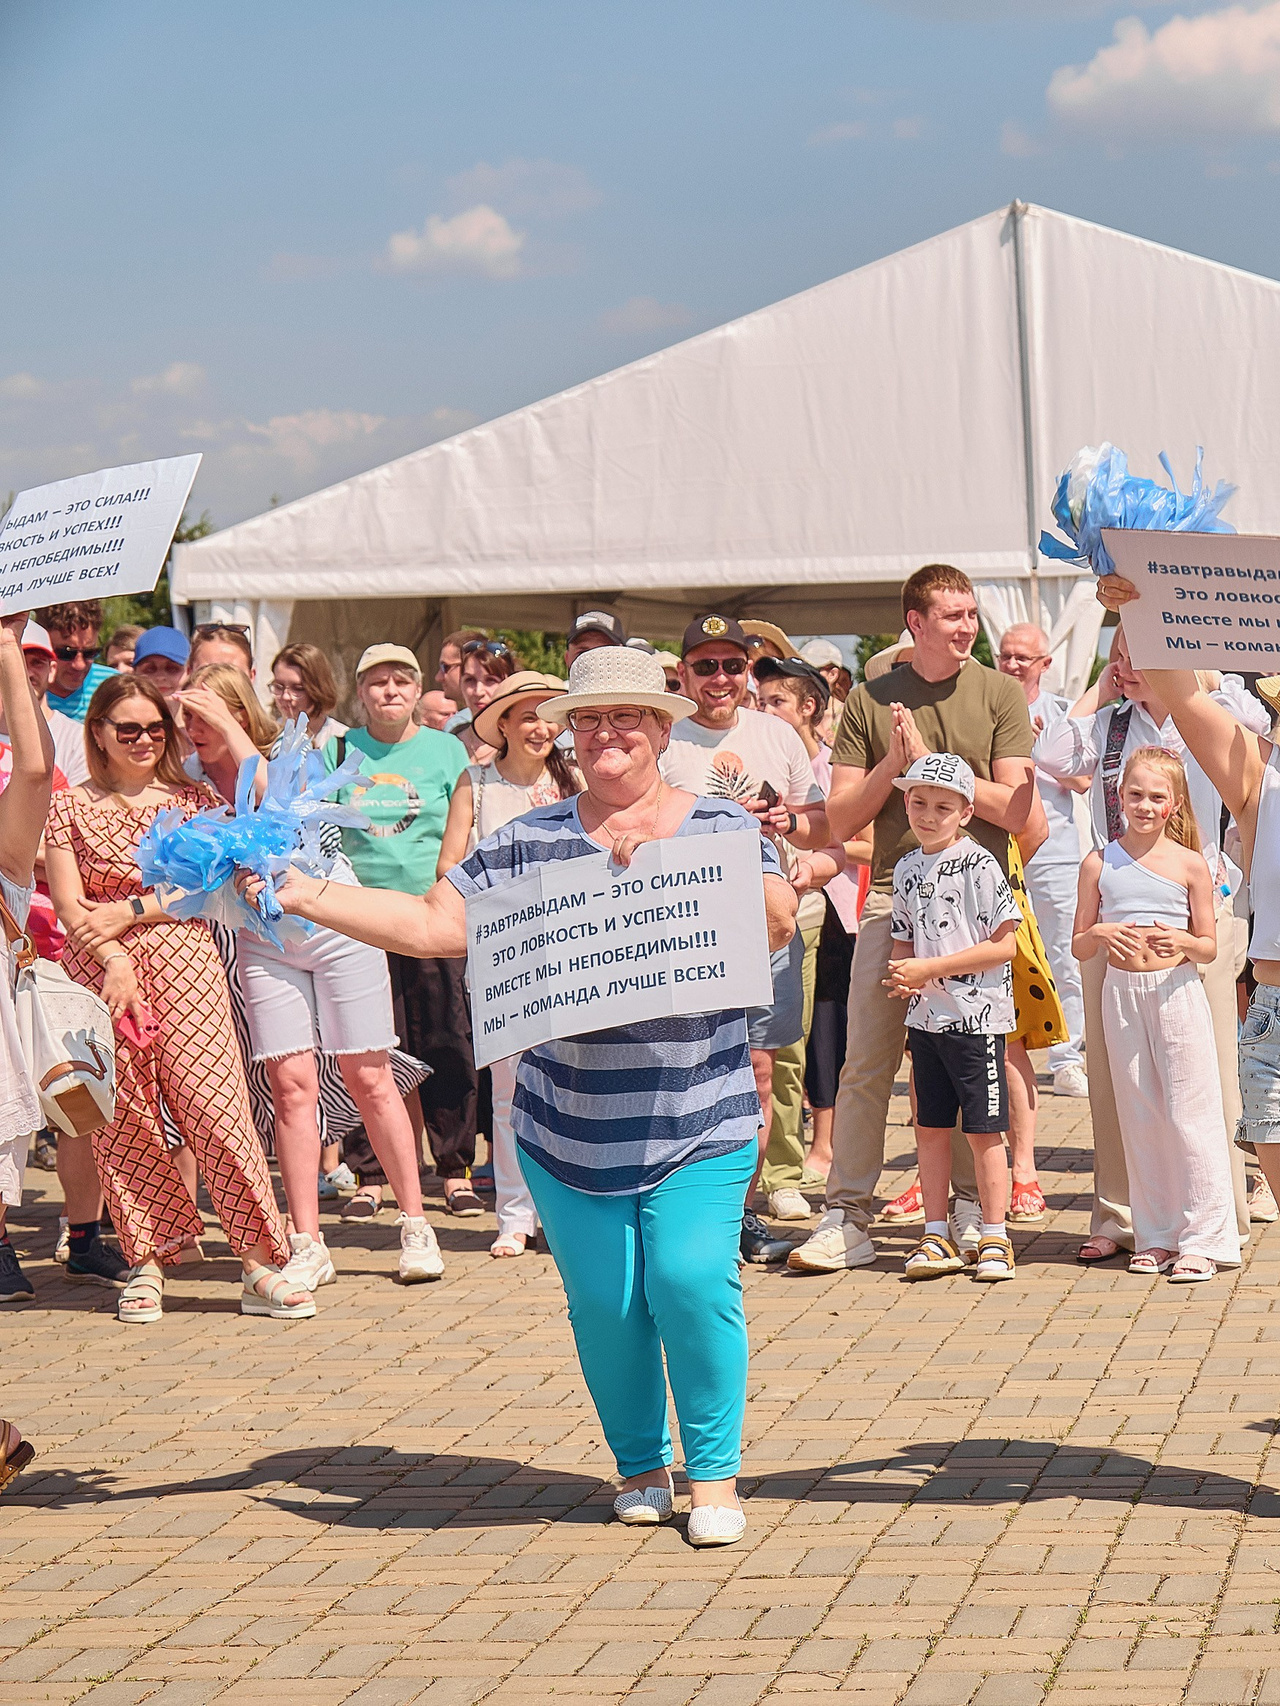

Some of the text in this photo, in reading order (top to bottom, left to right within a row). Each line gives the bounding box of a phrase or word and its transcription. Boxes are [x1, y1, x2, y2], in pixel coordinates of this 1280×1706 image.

[65, 500, 91, 515] ЭТО
[95, 487, 151, 508] СИЛА!!!
[49, 529, 60, 541] И
[63, 515, 123, 538] УСПЕХ!!!
[10, 538, 125, 572] НЕПОБЕДИМЫ!!!
[27, 570, 75, 591] ЛУЧШЕ
[79, 562, 120, 580] ВСЕХ!
[1174, 587, 1208, 600] Это
[1162, 611, 1232, 626] Вместе
[1239, 617, 1270, 628] мы
[1166, 636, 1201, 649] Мы
[937, 755, 960, 782] OCUS
[476, 892, 586, 945] #ЗАВТРАВЫДАМ
[611, 880, 643, 898] ЭТО
[651, 865, 722, 889] СИЛА!!!
[492, 900, 699, 967] ЭТО ЛОВКОСТЬ И УСПЕХ!!!
[485, 930, 717, 1002] ВМЕСТЕ МЫ НЕПОБЕДИМЫ!!!
[484, 1013, 505, 1035] МЫ
[523, 985, 600, 1019] КОМАНДА
[606, 971, 667, 997] ЛУЧШЕ
[674, 961, 725, 983] ВСЕХ!
[986, 1059, 998, 1081] TO
[987, 1081, 1000, 1117] WIN
